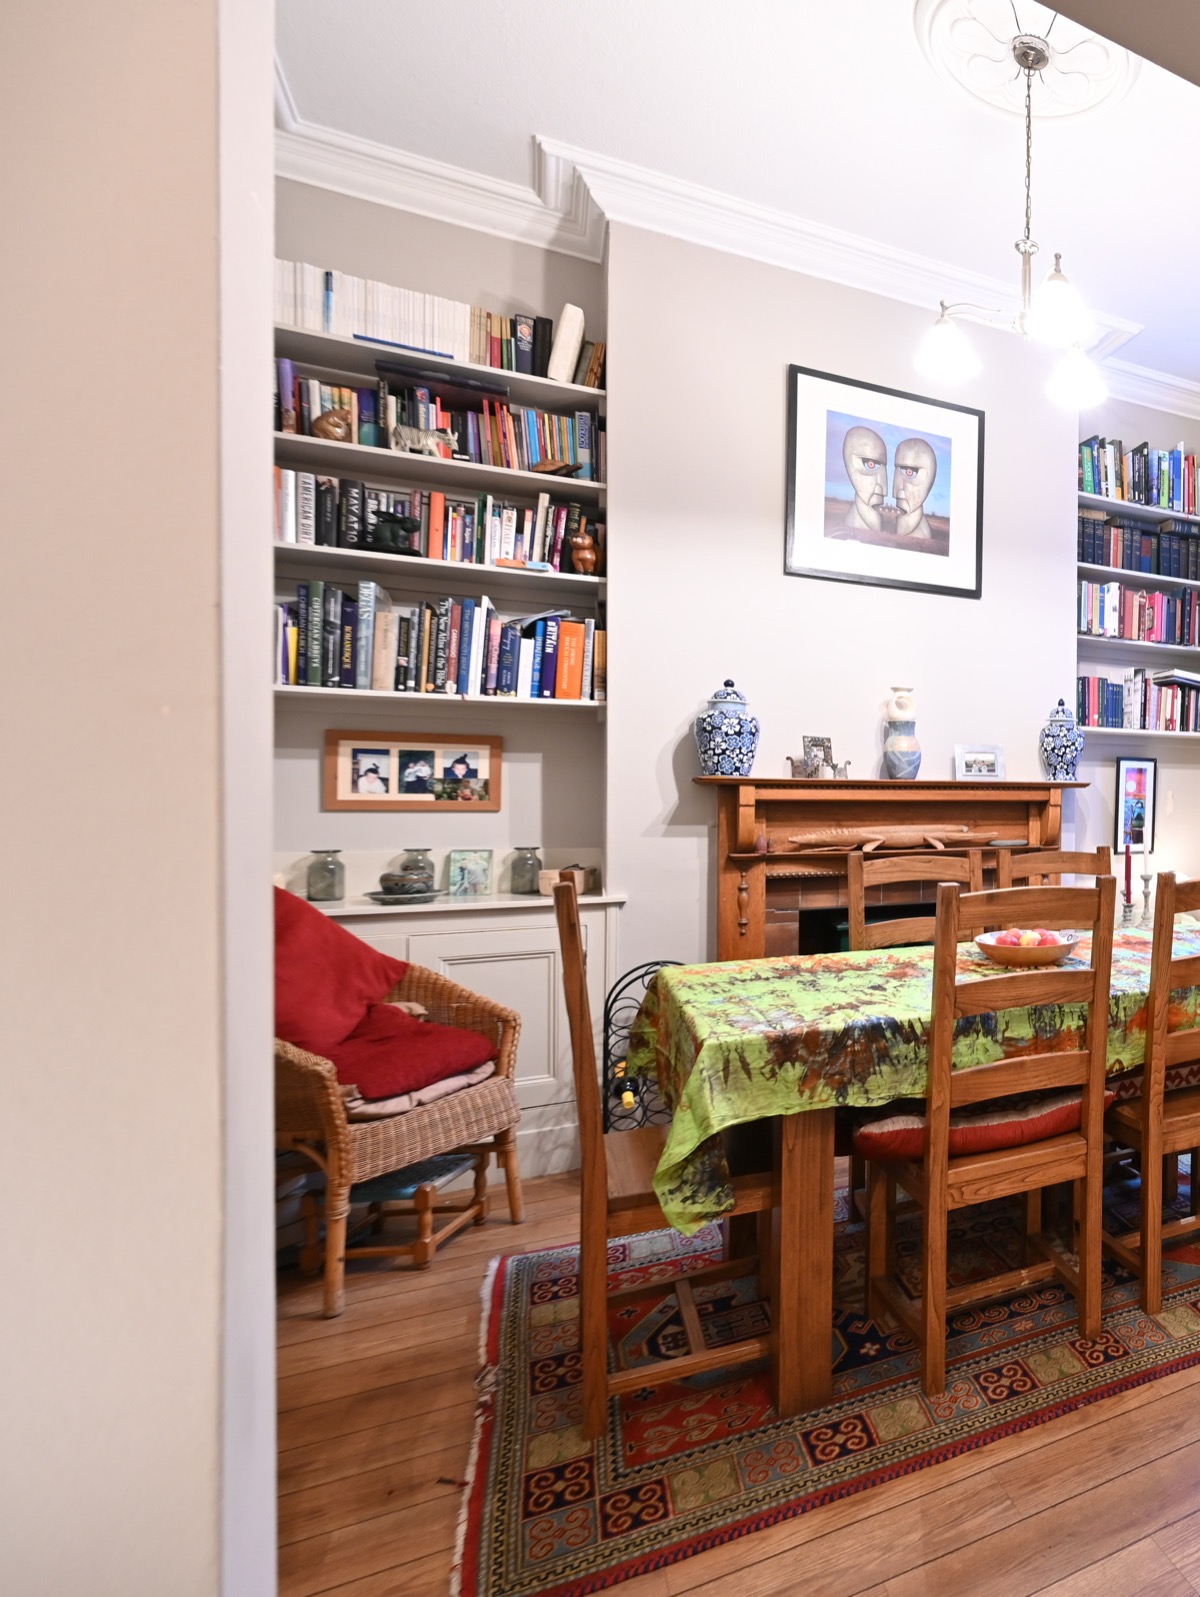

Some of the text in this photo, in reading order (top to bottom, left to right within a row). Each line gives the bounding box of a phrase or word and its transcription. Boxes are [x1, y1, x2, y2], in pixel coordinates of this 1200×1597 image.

[300, 480, 313, 520] AMERICAN
[346, 488, 360, 543] MAY AT 10
[300, 523, 312, 540] DIRT
[359, 581, 373, 620] DEGAS
[311, 597, 321, 668] CISTERCIAN ABBEYS
[341, 625, 353, 669] ROMANESQUE
[436, 600, 449, 686] The New Atlas of the Bible
[450, 629, 458, 659] CARAVAGGIO
[502, 628, 516, 651] Belonging
[545, 621, 557, 654] BRITAIN
[584, 639, 591, 652] DE
[534, 637, 542, 670] HERITAGE
[561, 657, 569, 690] COMMENTARY
[582, 652, 592, 692] CHARDIN
